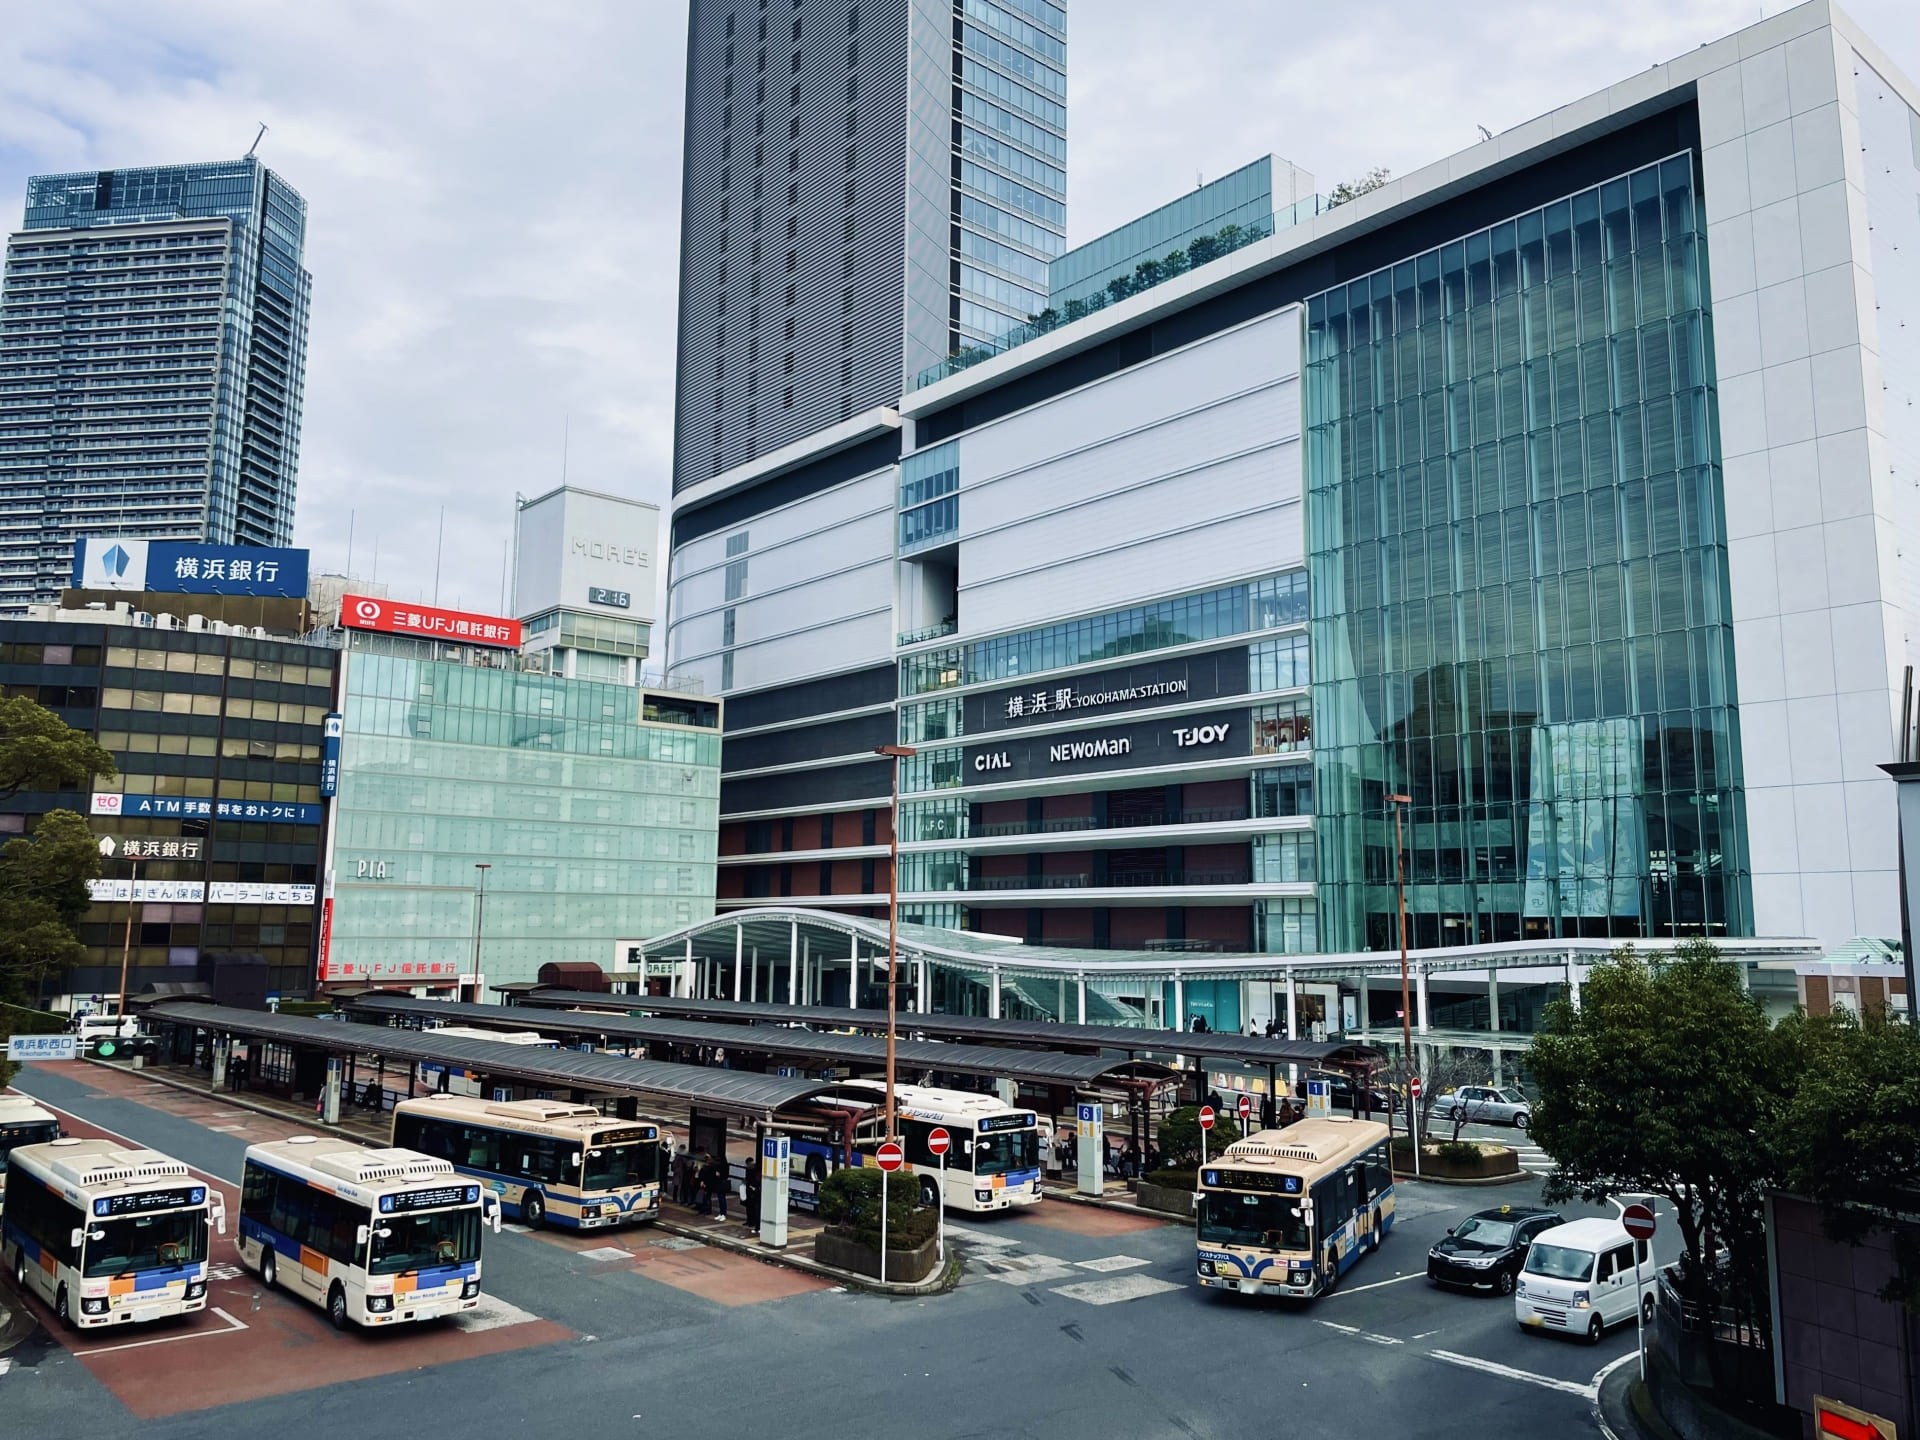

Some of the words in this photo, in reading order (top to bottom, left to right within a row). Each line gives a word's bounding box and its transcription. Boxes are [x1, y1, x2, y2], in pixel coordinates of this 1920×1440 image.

[175, 557, 279, 582] 横浜銀行
[393, 611, 510, 641] 三菱UFJ信託銀行
[1008, 687, 1072, 718] 横浜駅
[1076, 688, 1137, 707] YOKOHAMA
[1140, 679, 1187, 698] STATION
[974, 751, 1011, 771] CIAL
[122, 840, 199, 858] 横浜銀行
[357, 859, 386, 878] PIA
[116, 887, 203, 900] はまぎん保険
[14, 1038, 72, 1050] 横浜駅西口
[1313, 1083, 1318, 1094] 1
[1083, 1107, 1090, 1120] 6
[766, 1141, 774, 1156] 11
